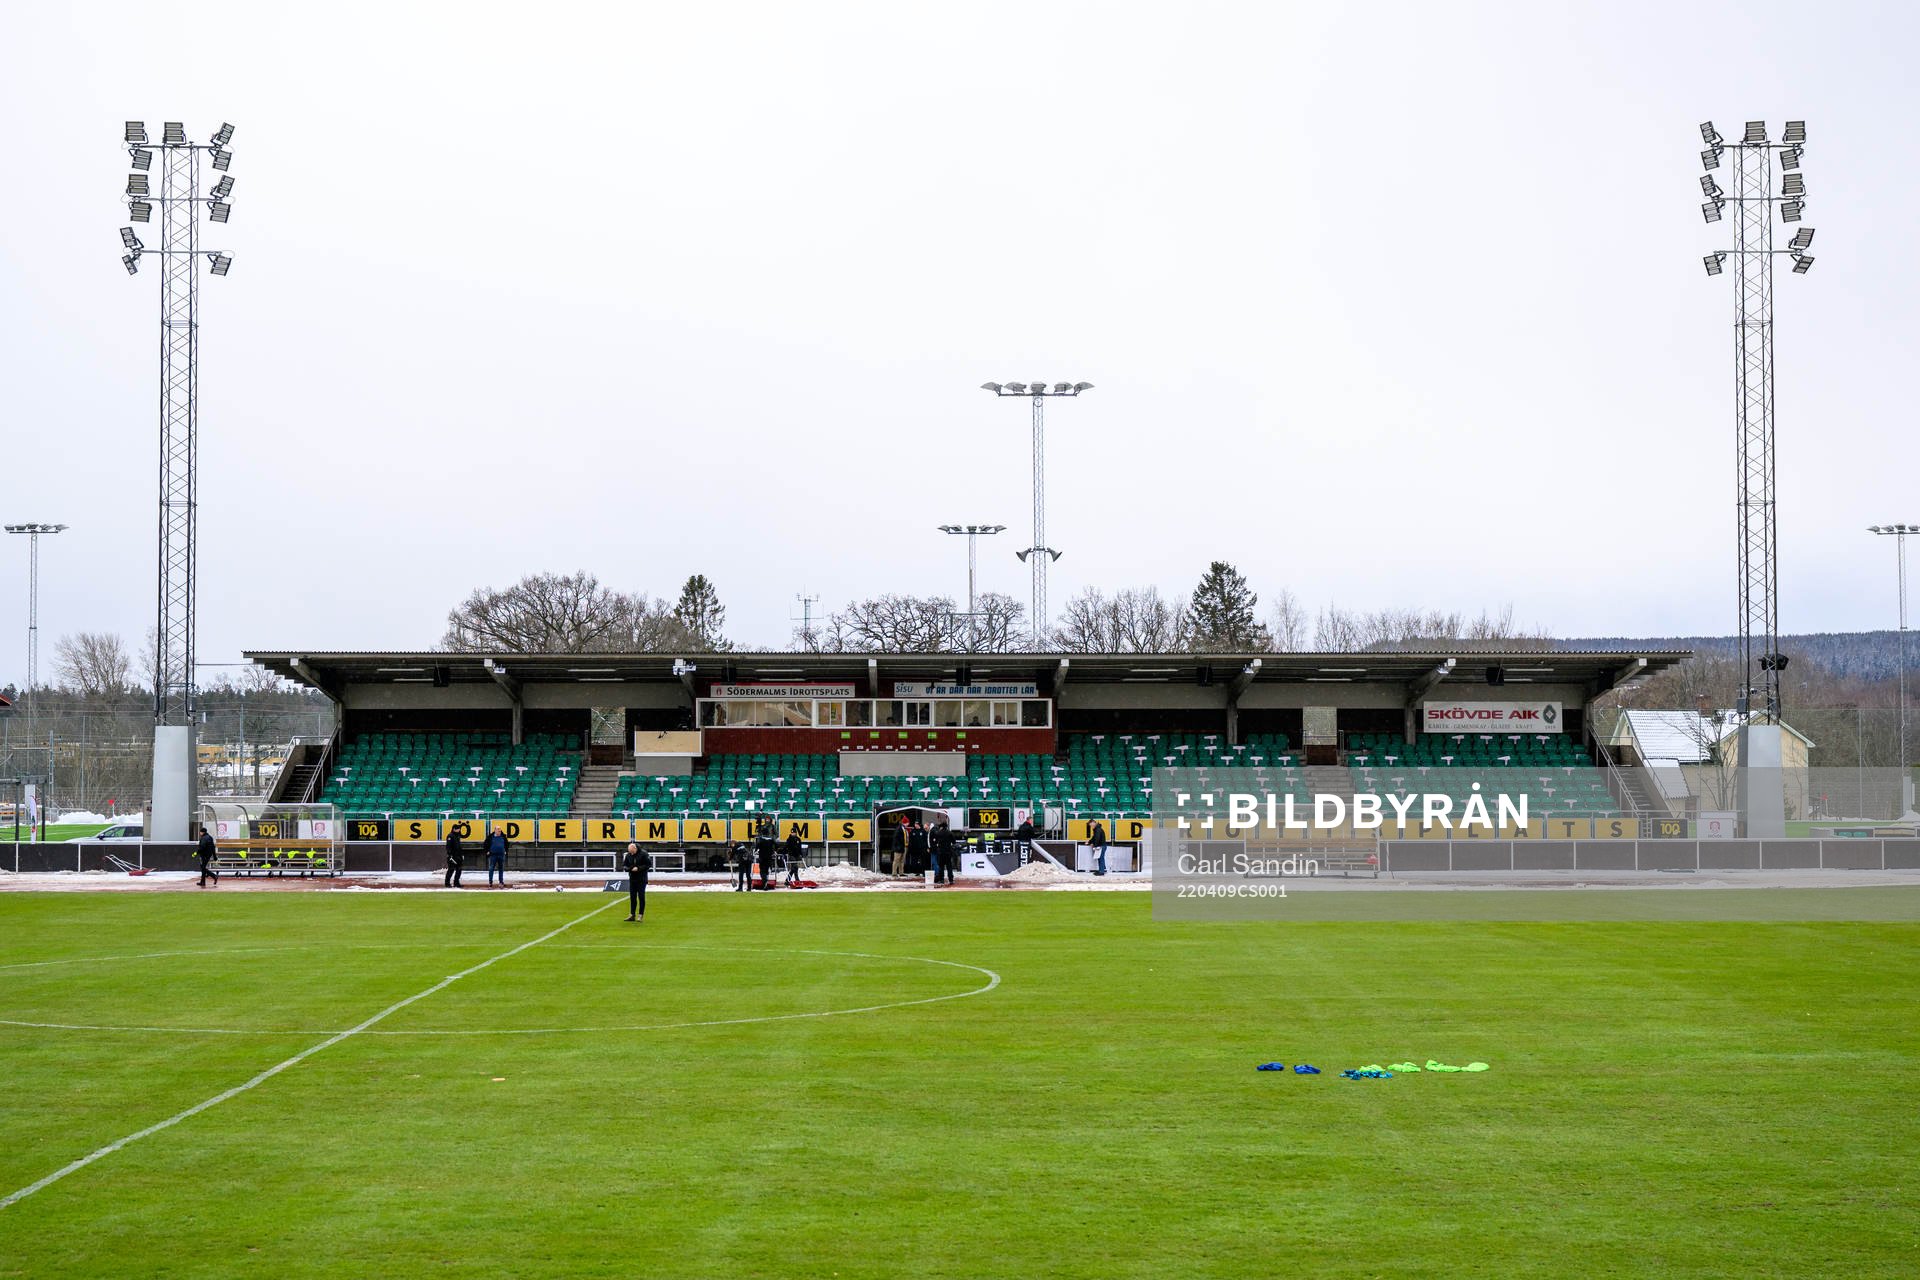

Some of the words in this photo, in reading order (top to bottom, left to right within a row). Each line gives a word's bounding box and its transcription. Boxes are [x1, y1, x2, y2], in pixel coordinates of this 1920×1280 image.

[789, 687, 850, 696] IDROTTSPLATS
[1427, 707, 1504, 720] SKÖVDE
[1508, 709, 1540, 720] AIK
[978, 812, 999, 825] 100
[357, 824, 378, 837] 100
